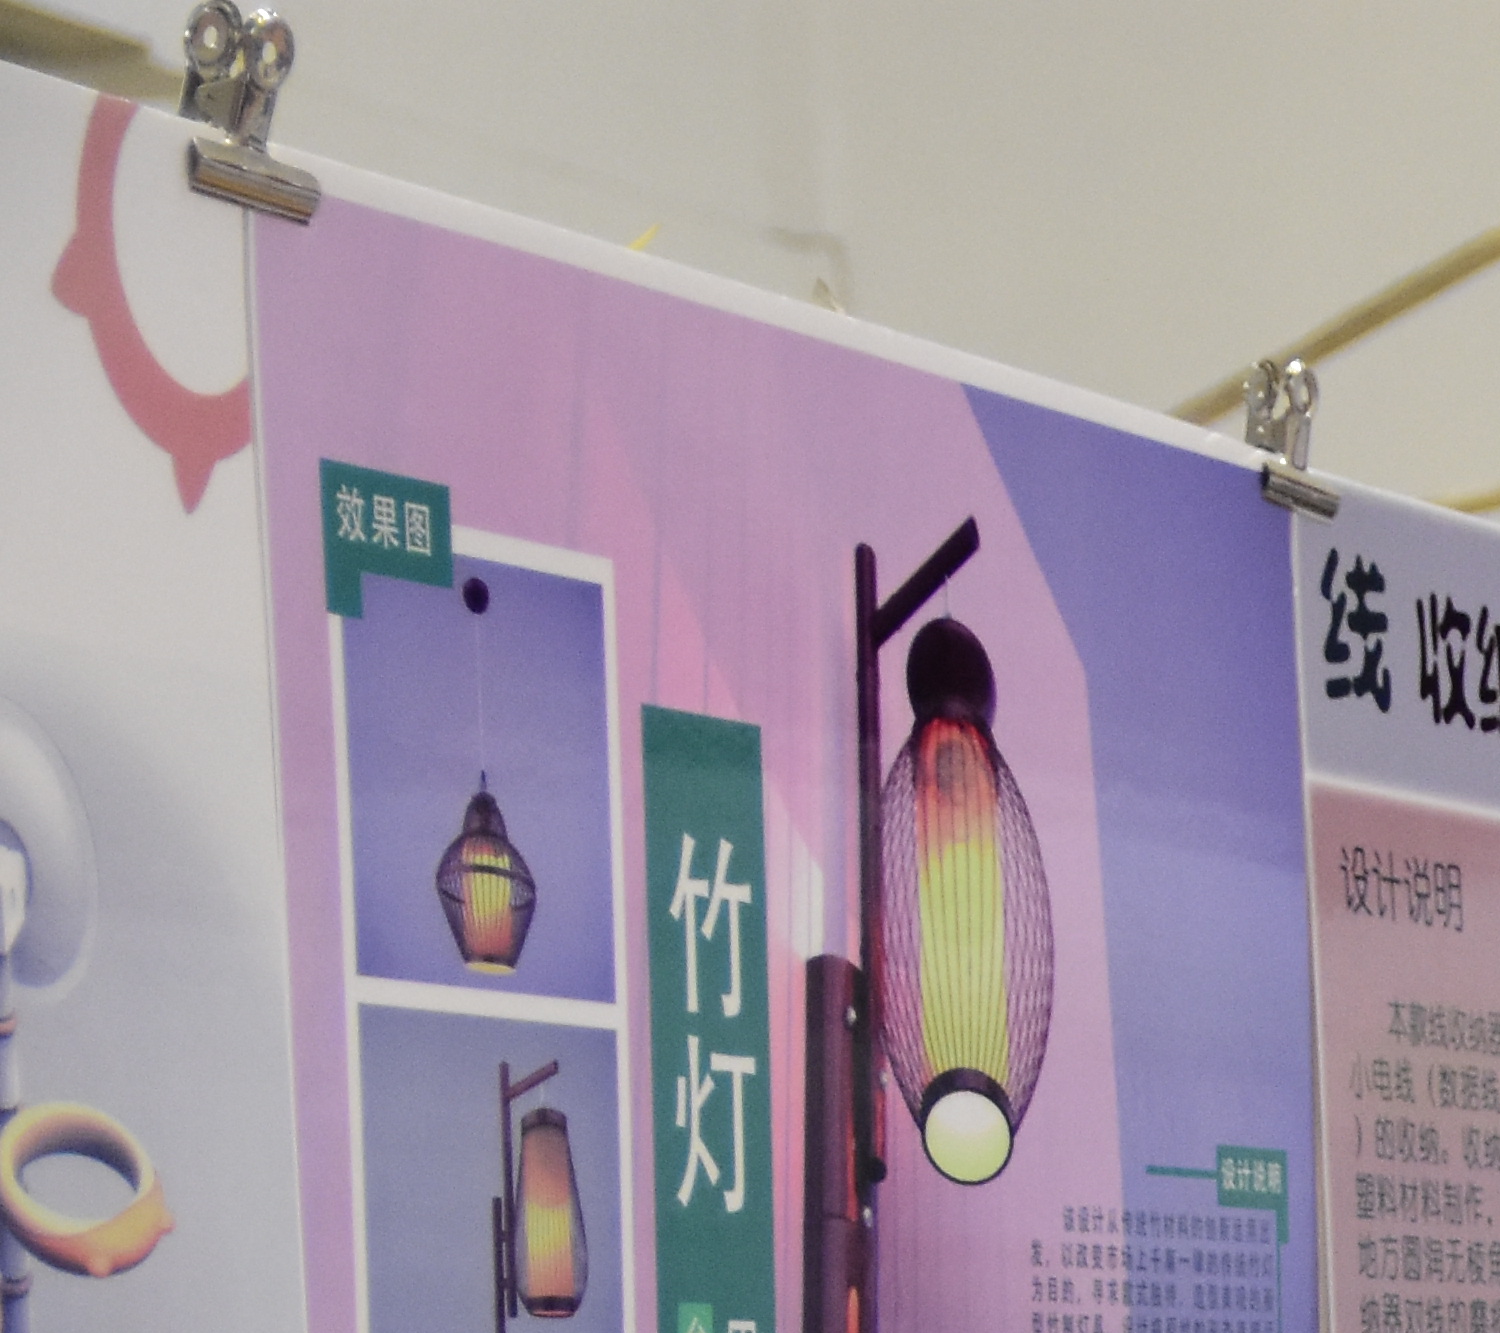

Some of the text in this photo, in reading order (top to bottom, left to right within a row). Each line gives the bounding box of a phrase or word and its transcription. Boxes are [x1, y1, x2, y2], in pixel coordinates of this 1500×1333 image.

[336, 483, 431, 557] 效果图
[1340, 846, 1465, 933] 设计说明
[669, 832, 756, 1213] 竹灯
[1221, 1156, 1283, 1195] 设计说明
